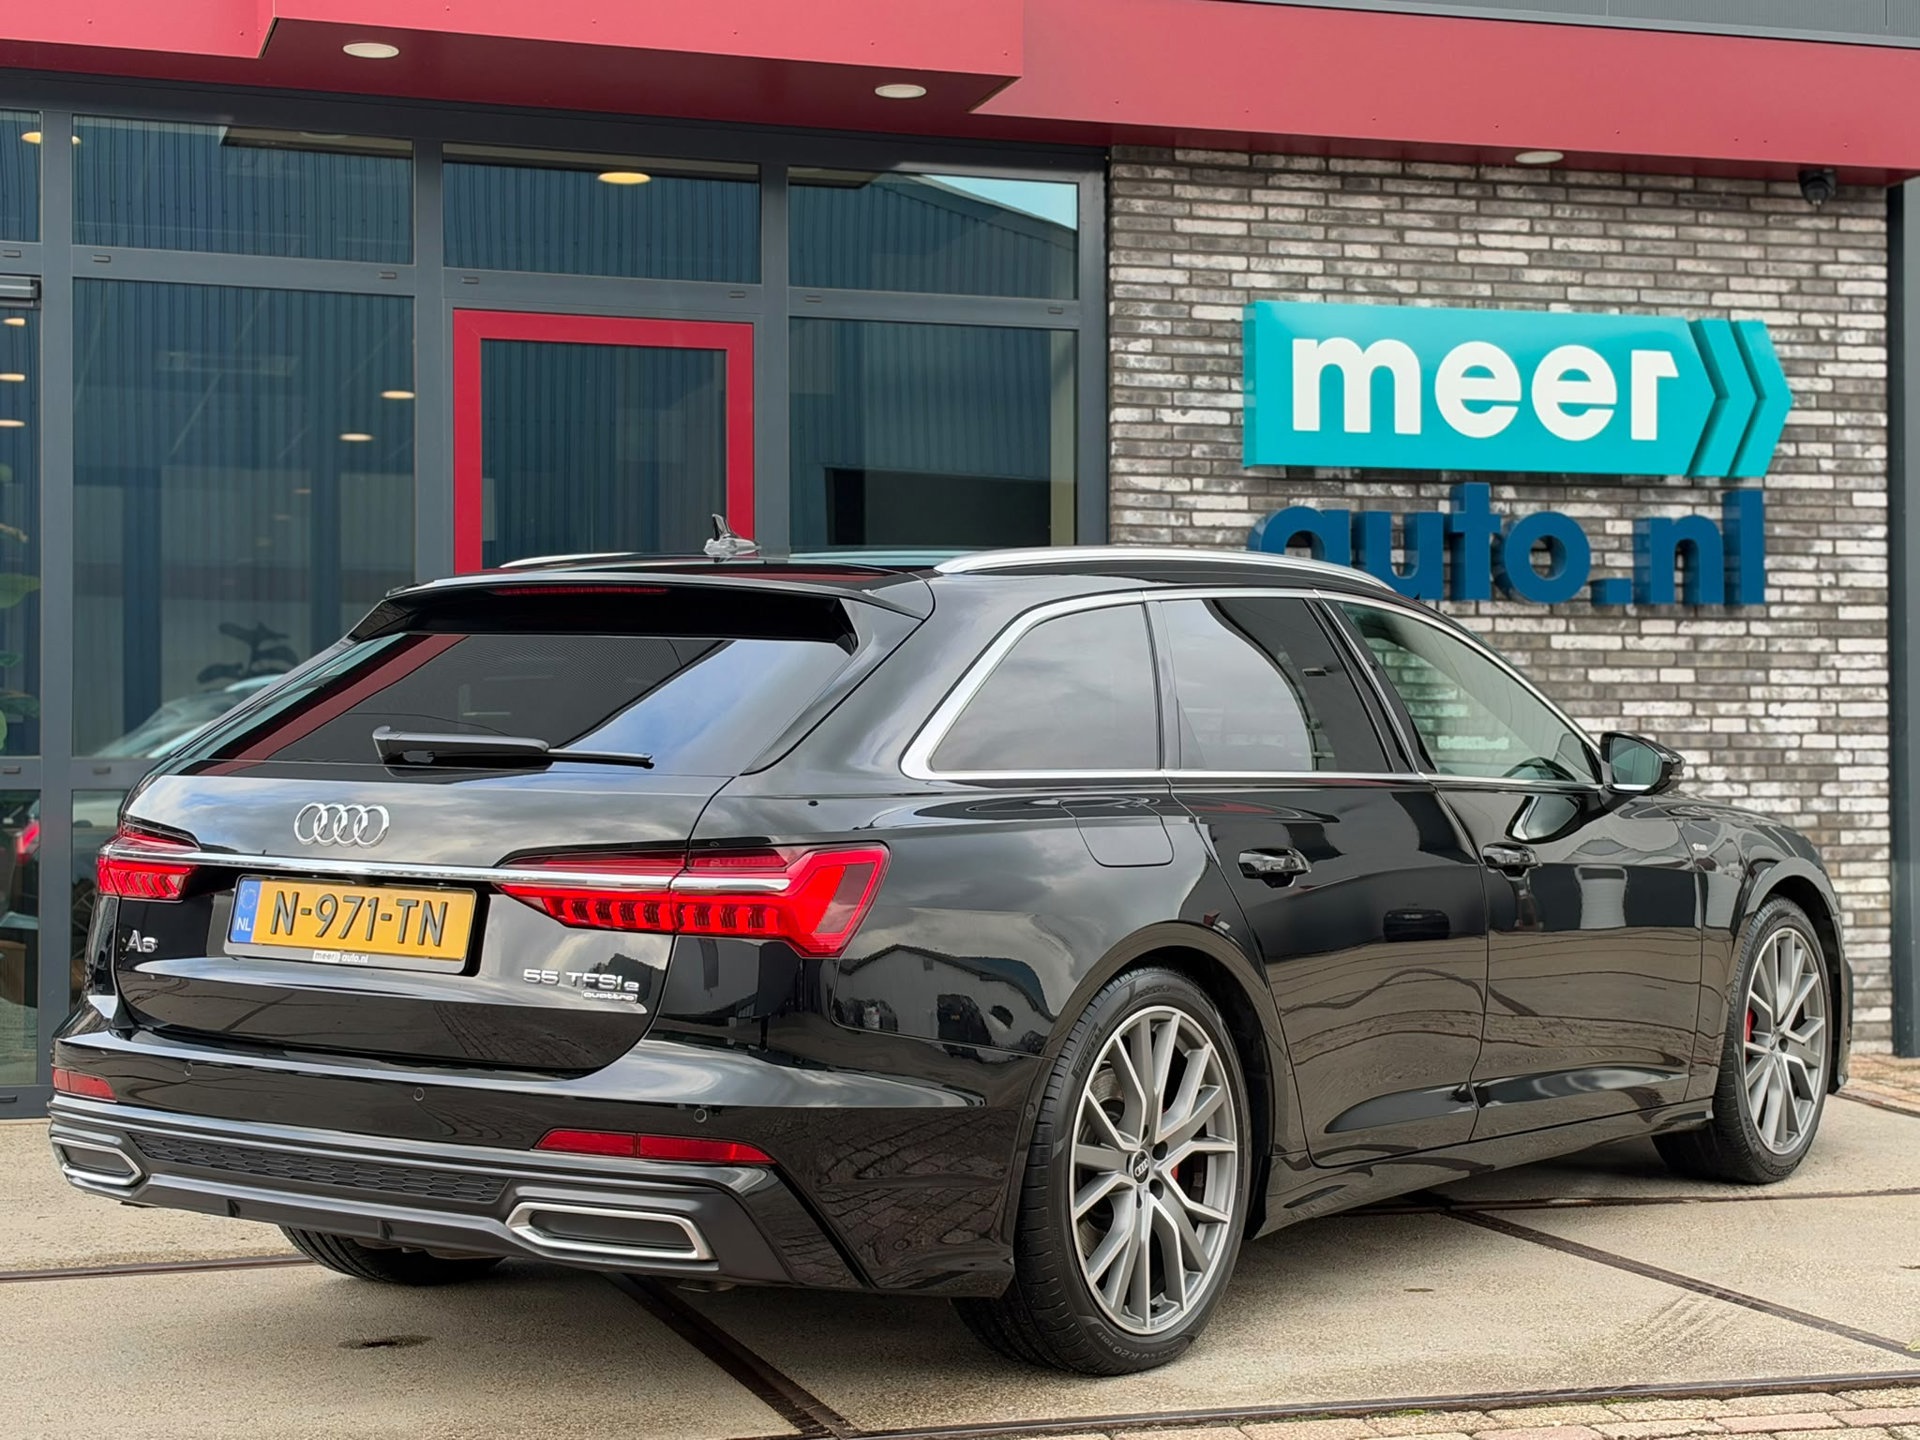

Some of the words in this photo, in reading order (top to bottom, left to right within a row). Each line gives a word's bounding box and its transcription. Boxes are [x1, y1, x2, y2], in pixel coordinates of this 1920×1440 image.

[1292, 337, 1679, 441] meer
[1247, 482, 1765, 605] auto.nl
[236, 917, 251, 931] NL
[270, 891, 448, 947] N-971-TN
[125, 929, 158, 953] A6
[341, 953, 369, 963] auto.nl
[522, 968, 560, 985] 55
[583, 991, 635, 1002] quattro
